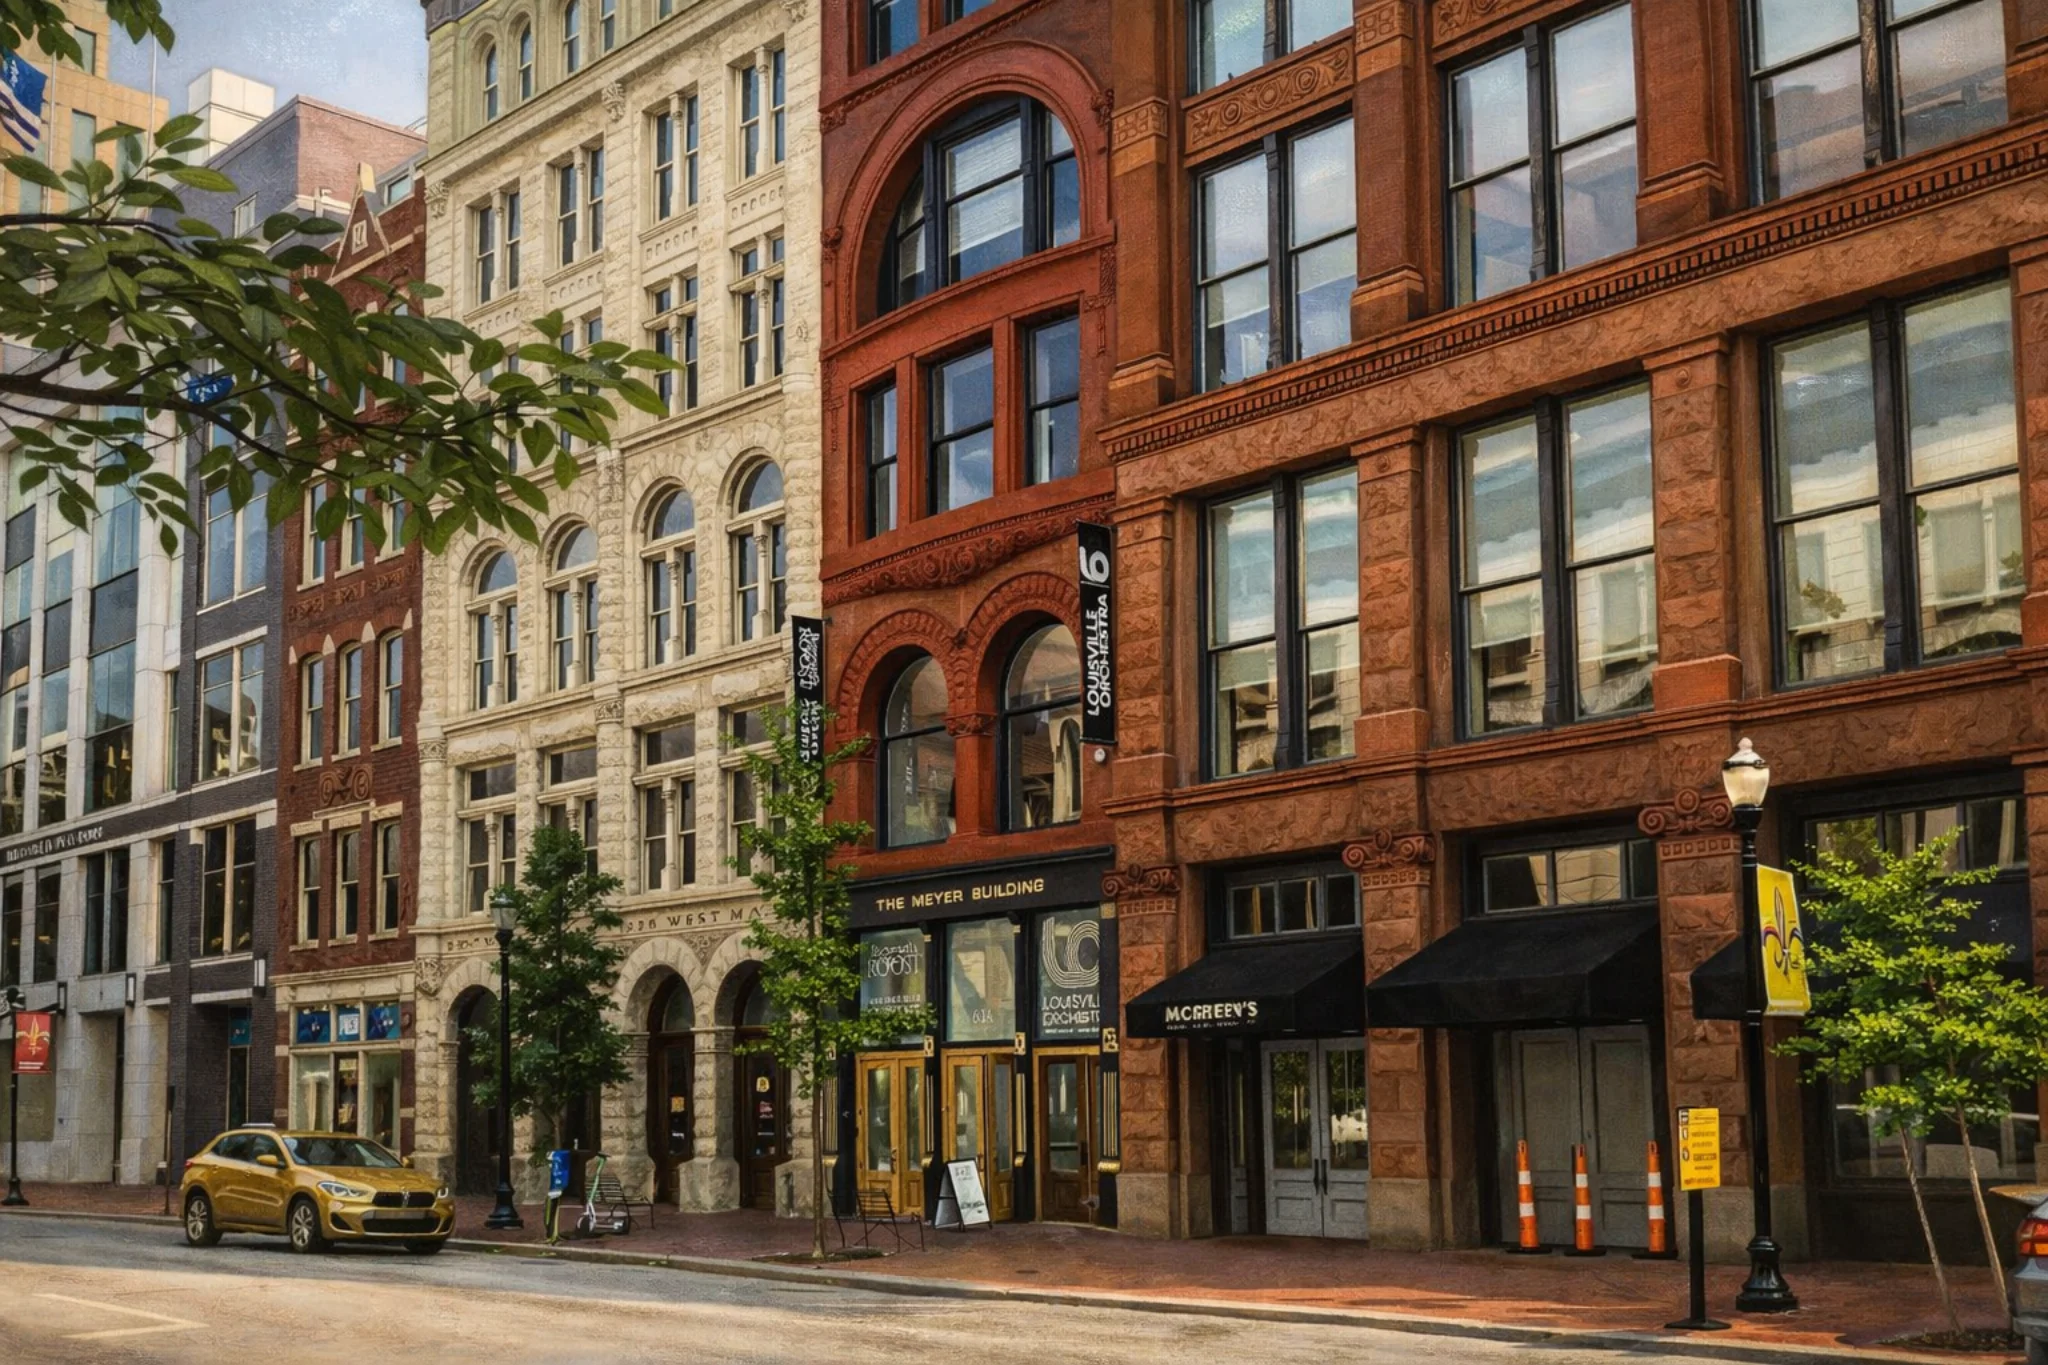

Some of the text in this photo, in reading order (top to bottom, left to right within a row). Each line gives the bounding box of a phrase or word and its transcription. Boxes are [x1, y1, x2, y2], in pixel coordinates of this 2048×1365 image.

[1086, 609, 1100, 716] LOUISVILLE
[1098, 594, 1112, 708] ORCHESTRA
[667, 910, 721, 926] WEST
[876, 878, 1045, 911] THE MEYER BUILDING
